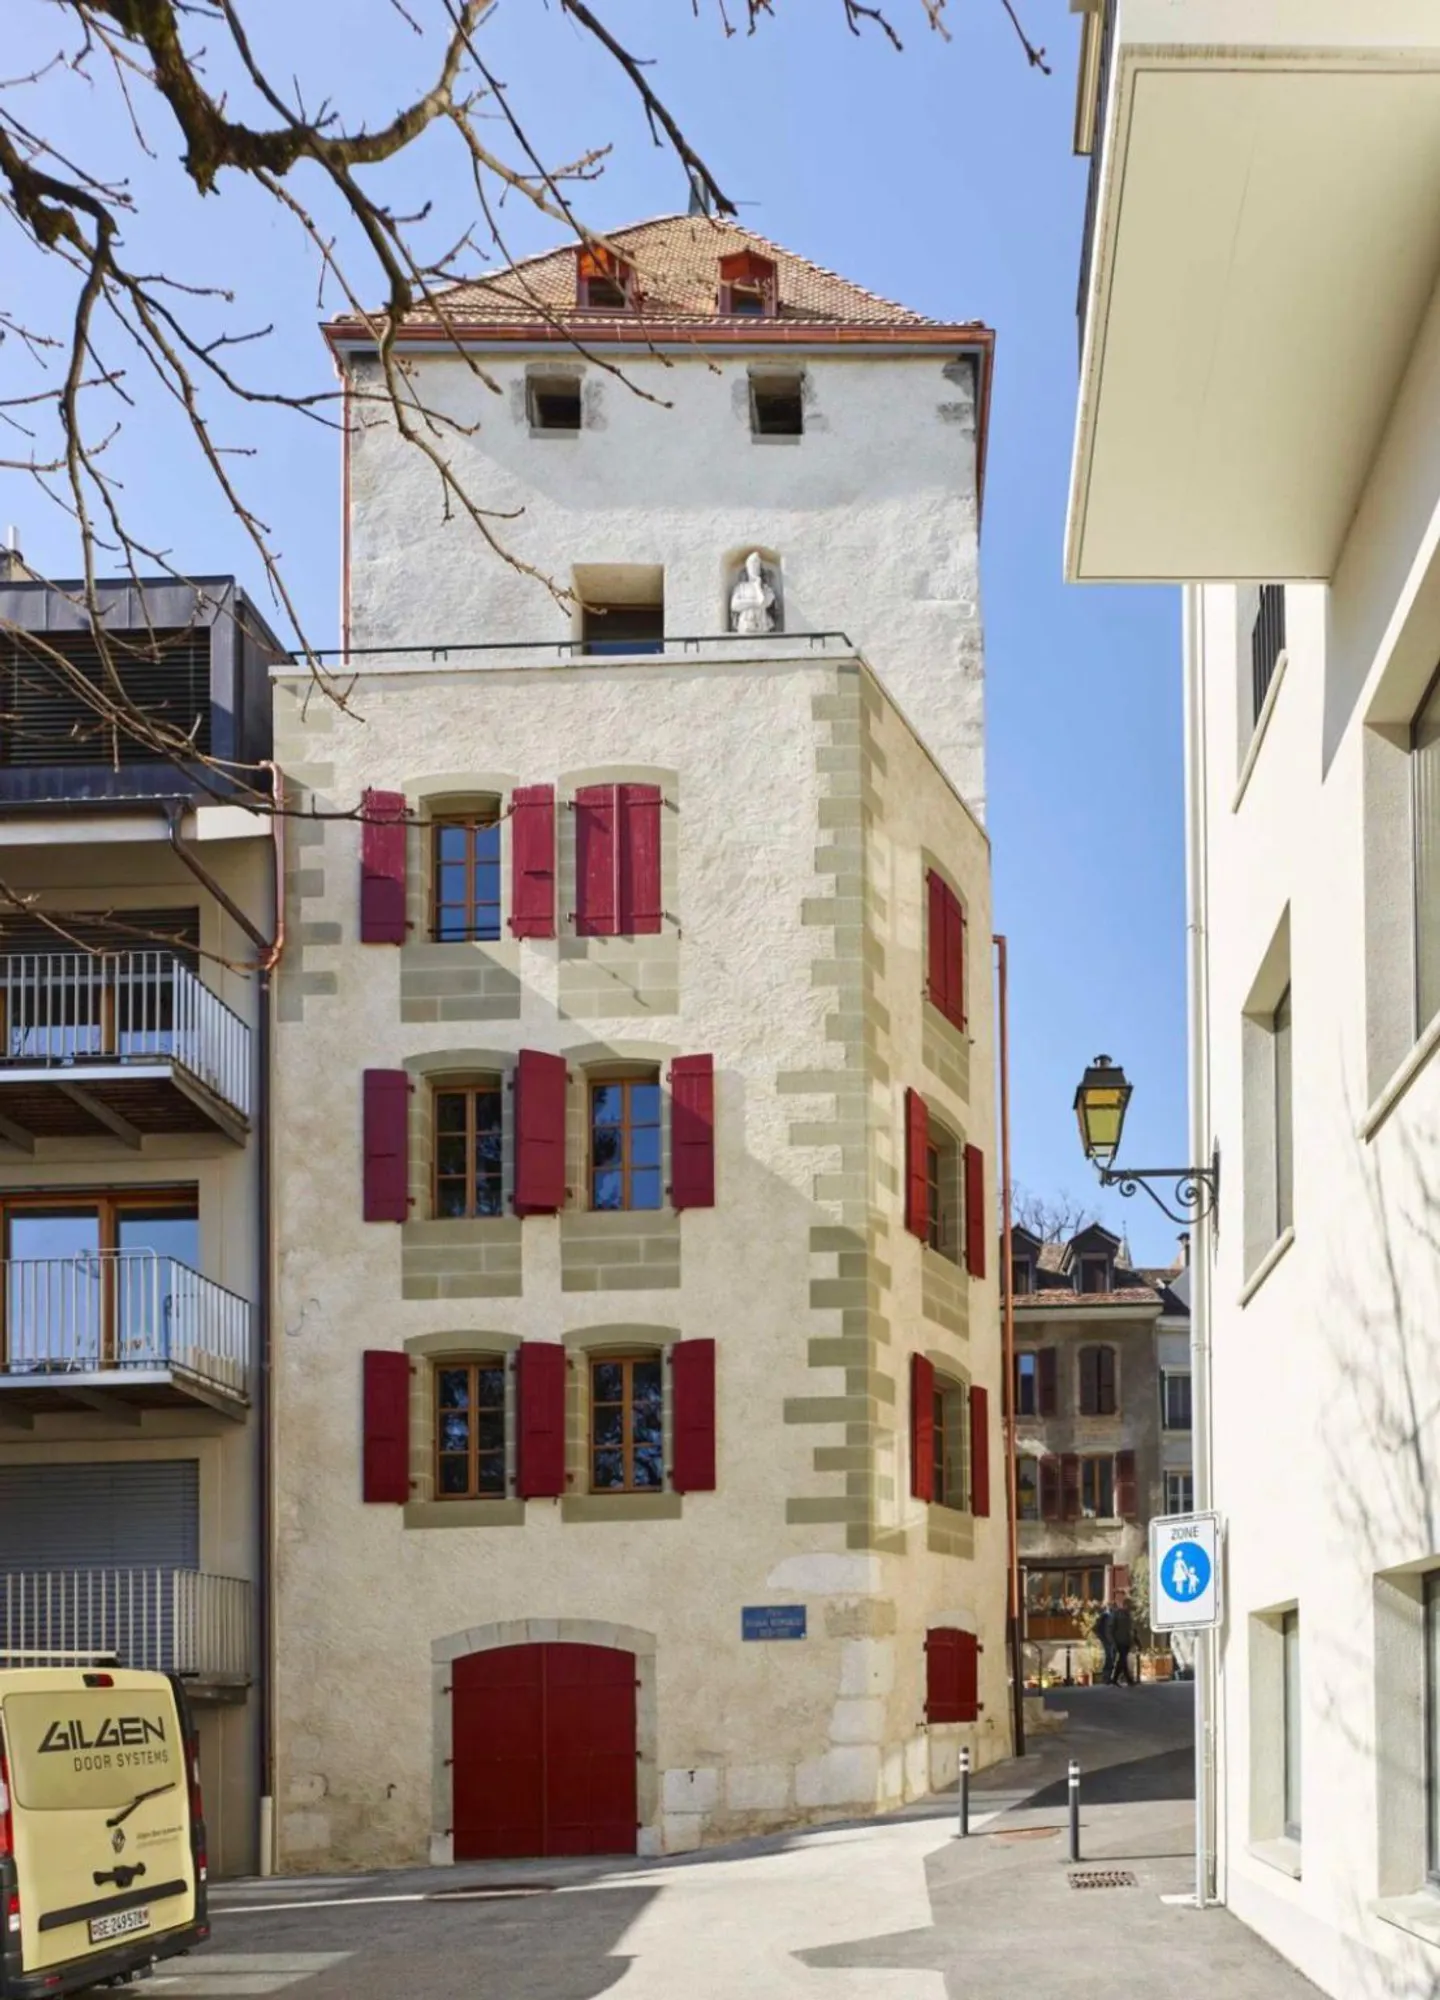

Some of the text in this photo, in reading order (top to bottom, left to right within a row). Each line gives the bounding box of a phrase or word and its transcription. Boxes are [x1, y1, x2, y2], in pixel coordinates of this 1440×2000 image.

[1171, 1526, 1199, 1540] ZONE
[37, 1716, 165, 1753] GILGEN
[74, 1749, 168, 1772] DOOR SYSTEMS
